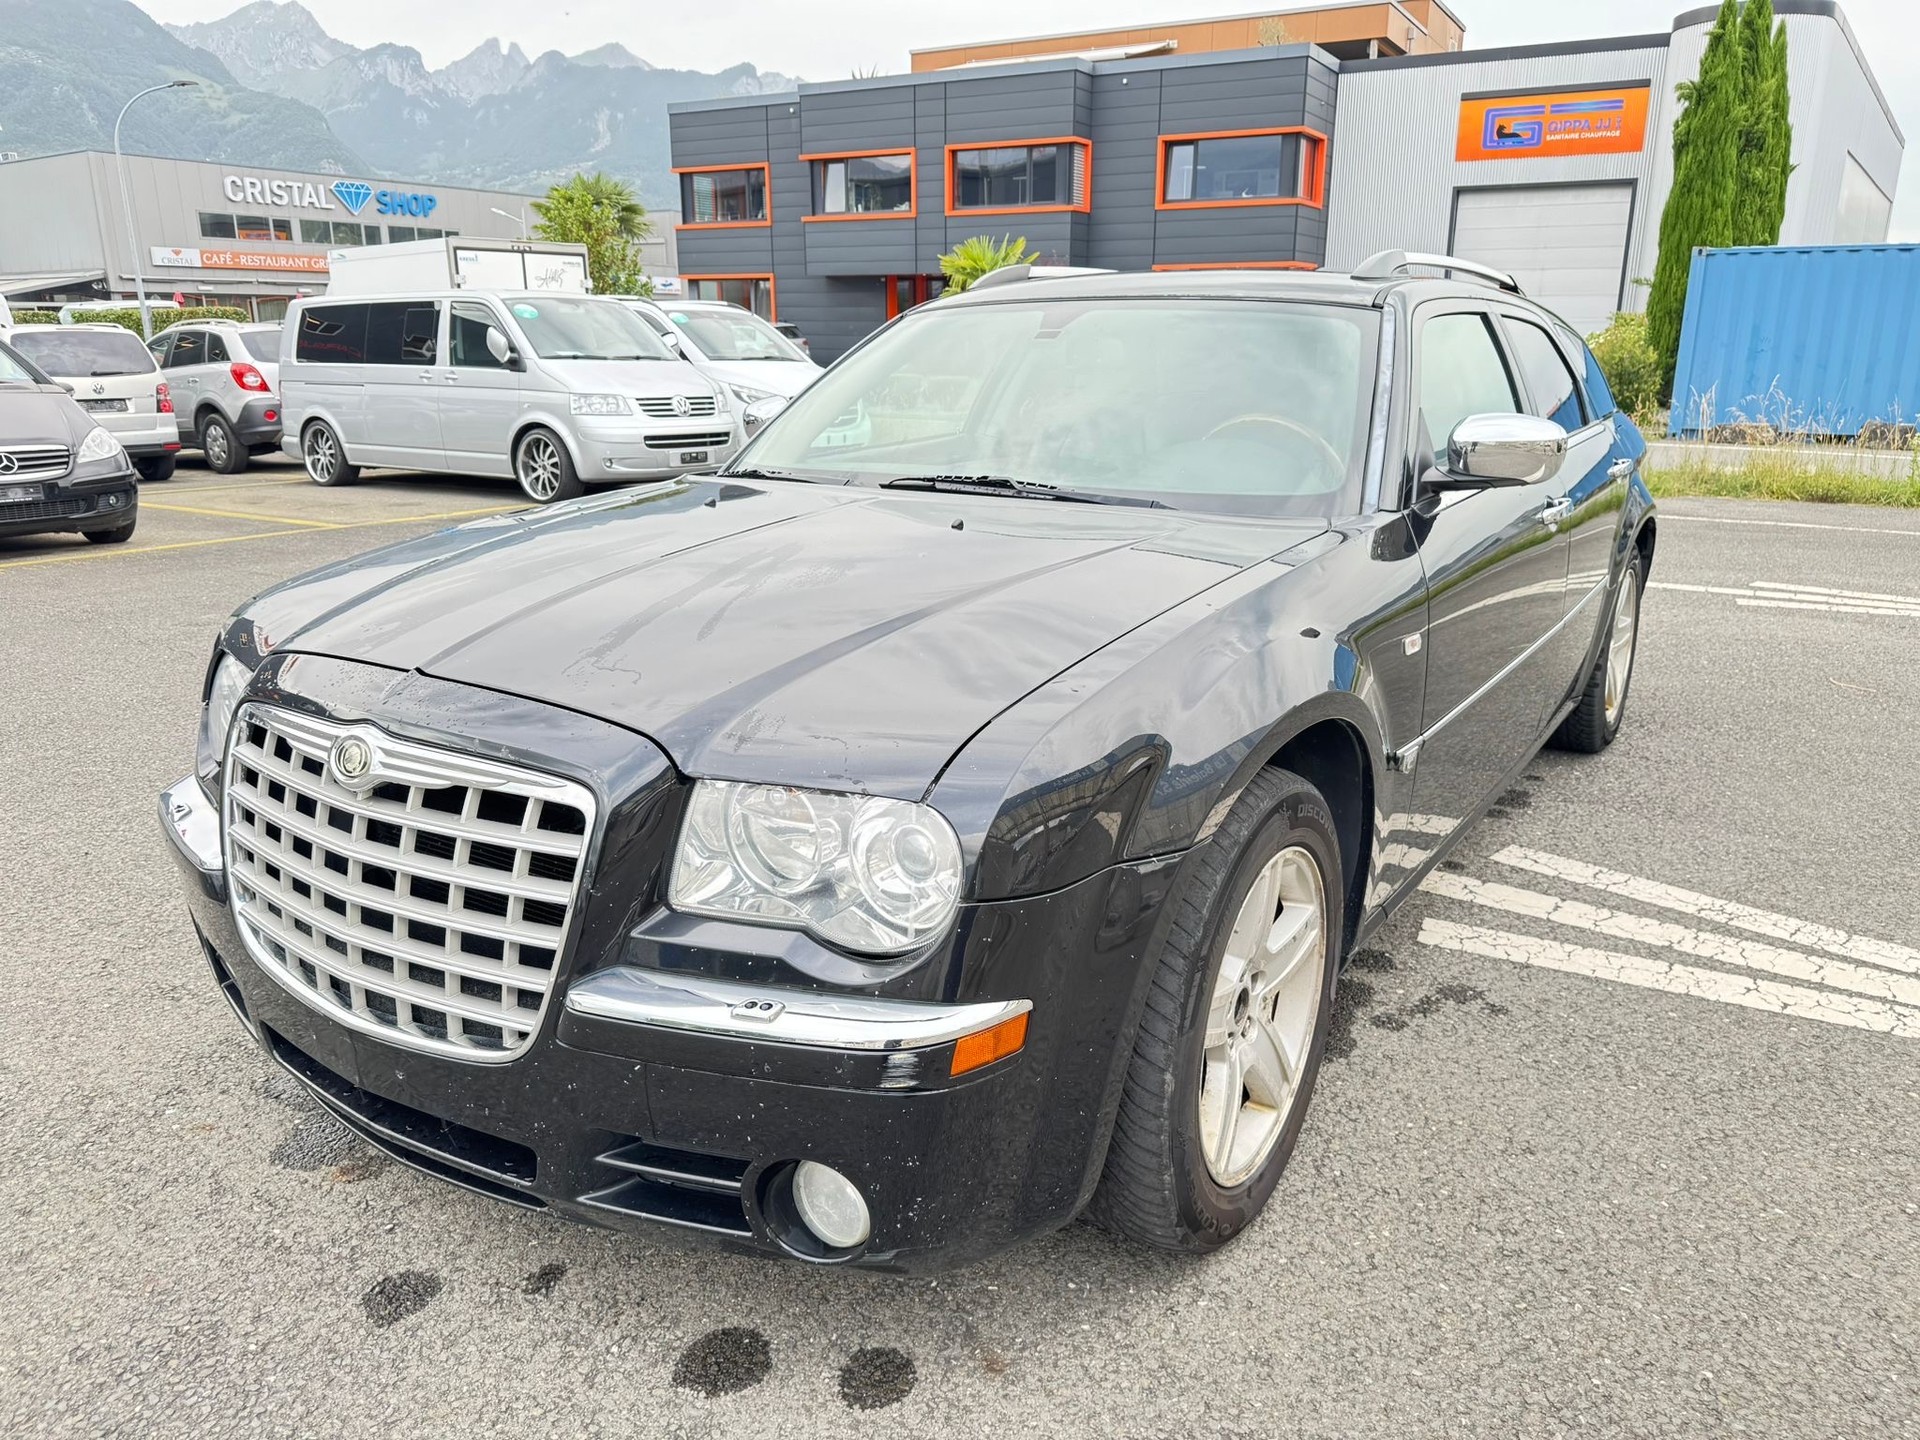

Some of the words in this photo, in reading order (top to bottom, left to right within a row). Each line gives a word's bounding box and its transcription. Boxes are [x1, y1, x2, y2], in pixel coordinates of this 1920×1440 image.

[1546, 132, 1580, 141] SANITAIRE
[1580, 130, 1621, 139] CHAUFFAGE
[224, 174, 336, 210] CRISTAL
[376, 189, 438, 218] SHOP
[161, 256, 195, 266] CRISTAL
[203, 252, 233, 265] CAFÉ
